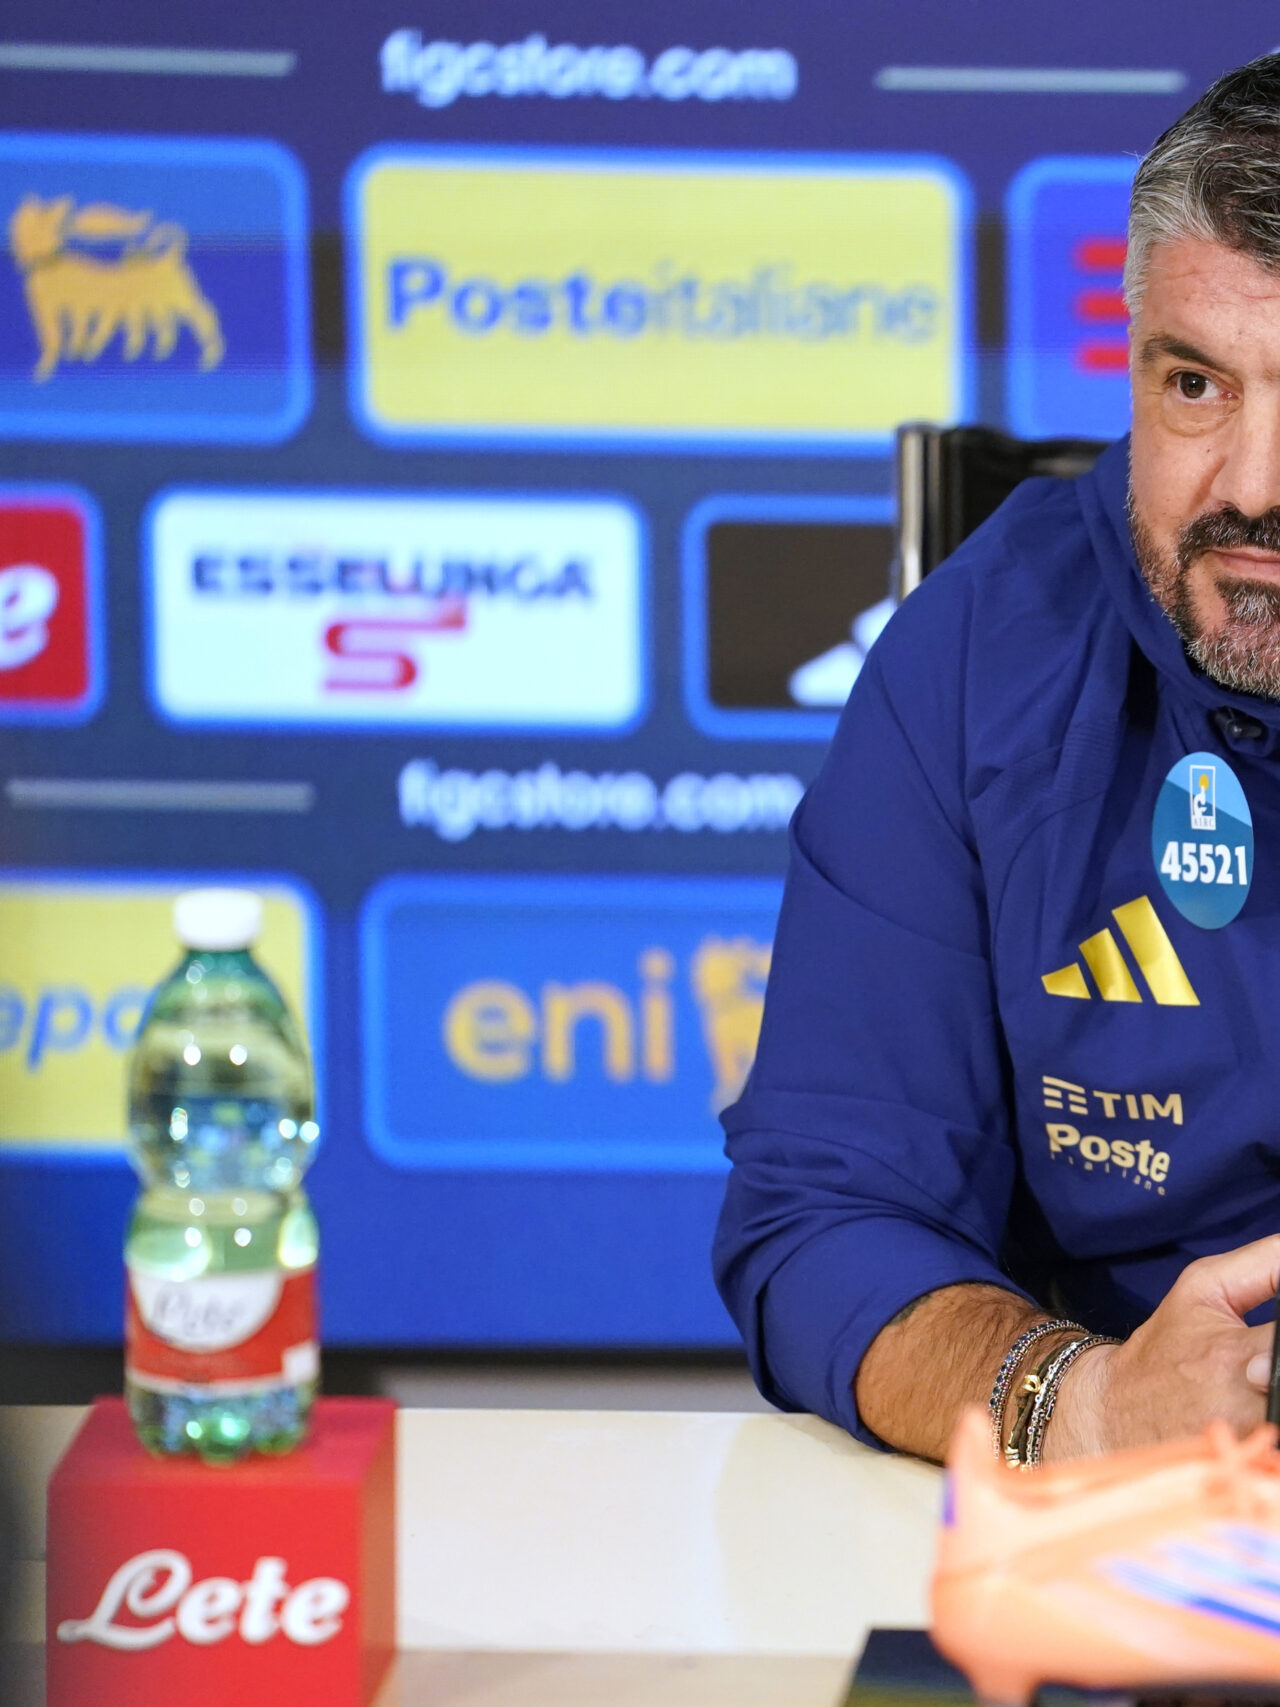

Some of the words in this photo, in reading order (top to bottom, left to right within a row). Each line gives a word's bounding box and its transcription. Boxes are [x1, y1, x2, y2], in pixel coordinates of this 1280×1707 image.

[1160, 841, 1248, 886] 45521
[443, 944, 677, 1084] eni
[1092, 1090, 1184, 1126] TIM
[1046, 1123, 1171, 1182] Poste
[57, 1548, 351, 1652] Lete
